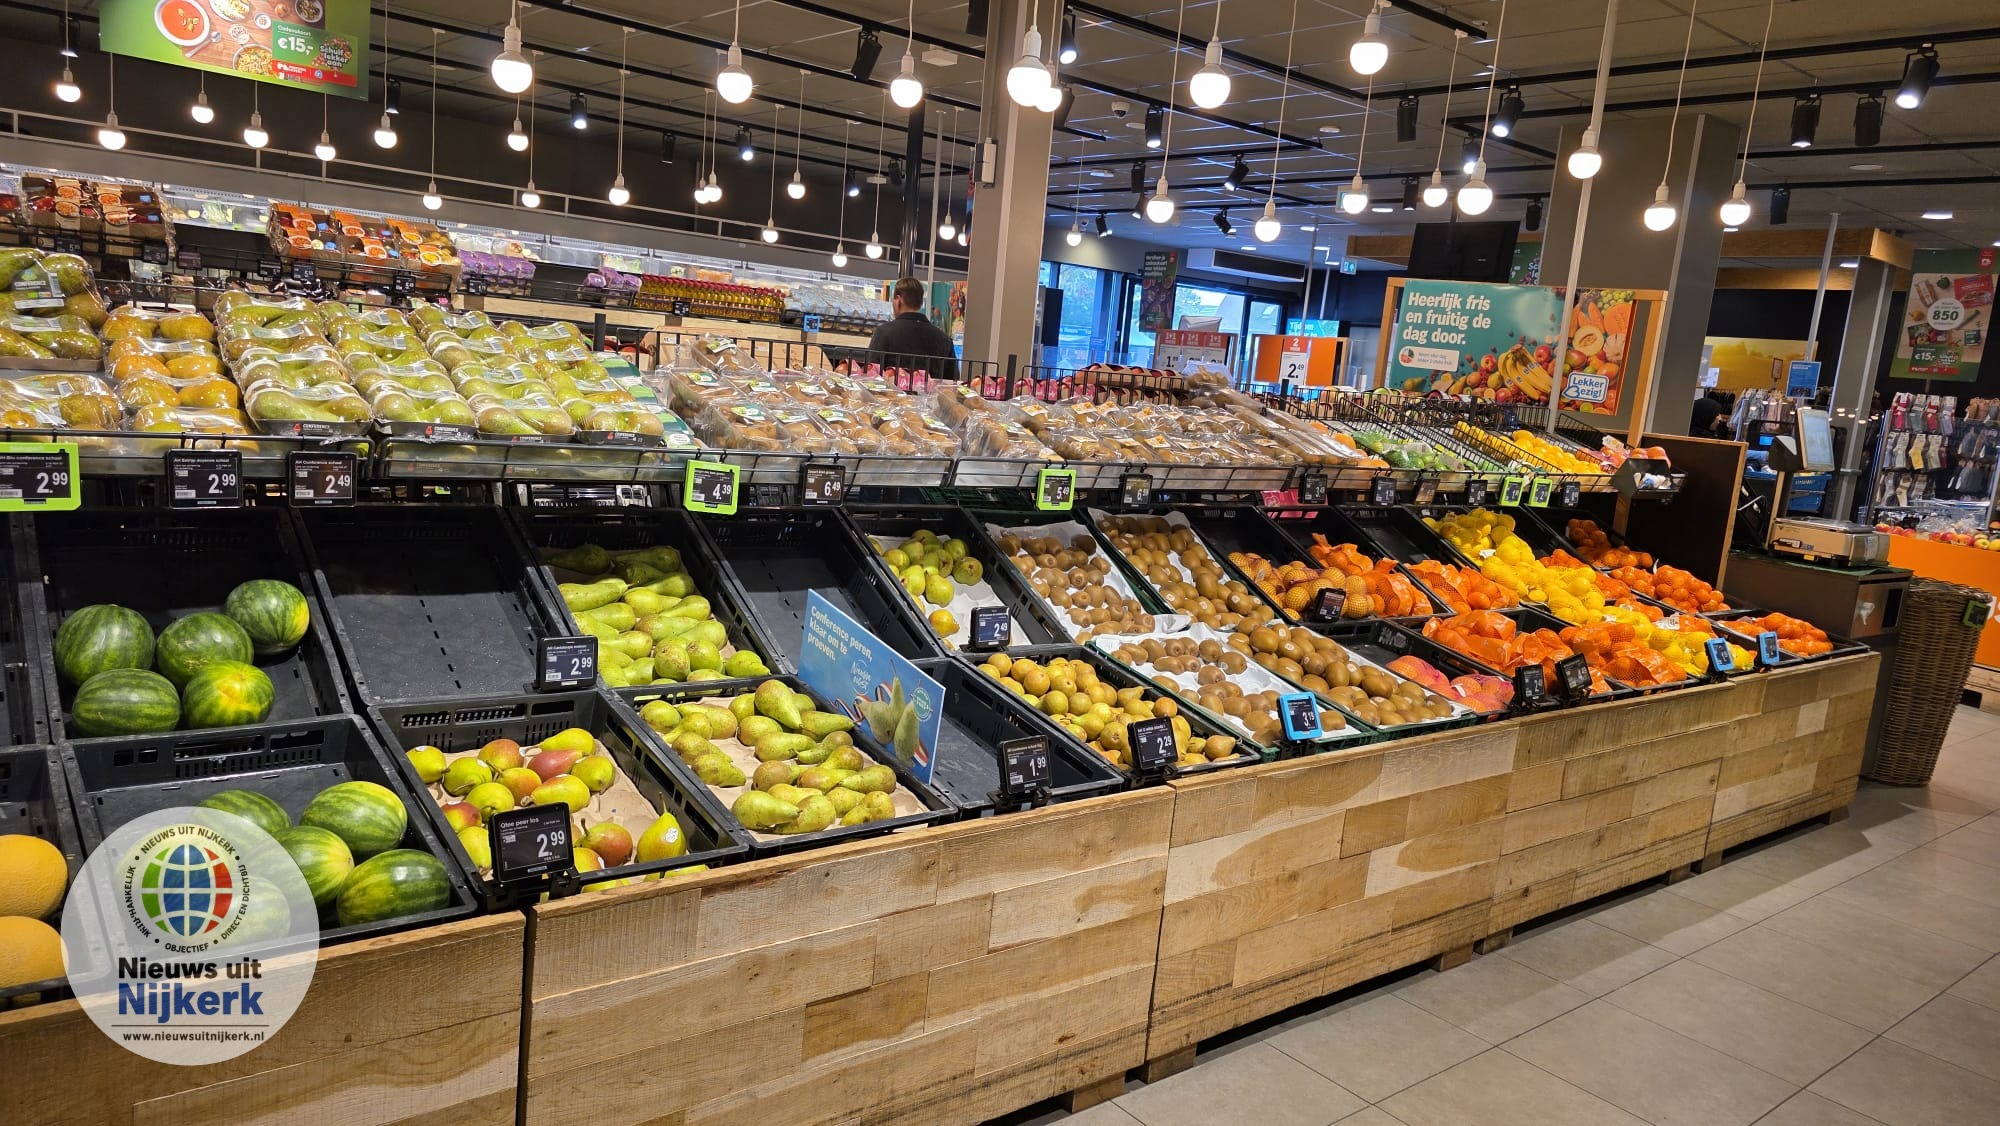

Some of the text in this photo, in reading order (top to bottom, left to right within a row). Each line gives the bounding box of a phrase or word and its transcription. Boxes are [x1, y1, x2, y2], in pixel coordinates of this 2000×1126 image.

[1408, 292, 1491, 311] Heerlijk fris
[1405, 309, 1491, 331] en fruitig de
[1932, 310, 1959, 321] 850
[1292, 338, 1299, 347] 2
[1402, 325, 1466, 345] dag door.
[1573, 376, 1605, 388] Lekker
[36, 472, 68, 494] 2.99
[208, 473, 236, 494] 2.99
[325, 474, 351, 494] 2.49
[712, 483, 732, 500] 4.39
[824, 481, 840, 496] 6.49
[809, 617, 848, 655] klaar om te
[811, 605, 873, 663] Conference peren,
[807, 632, 836, 661] proeven.
[570, 657, 592, 675] 2.99
[1029, 756, 1046, 777] 1.99
[515, 819, 529, 827] peer
[536, 830, 565, 858] 2.99
